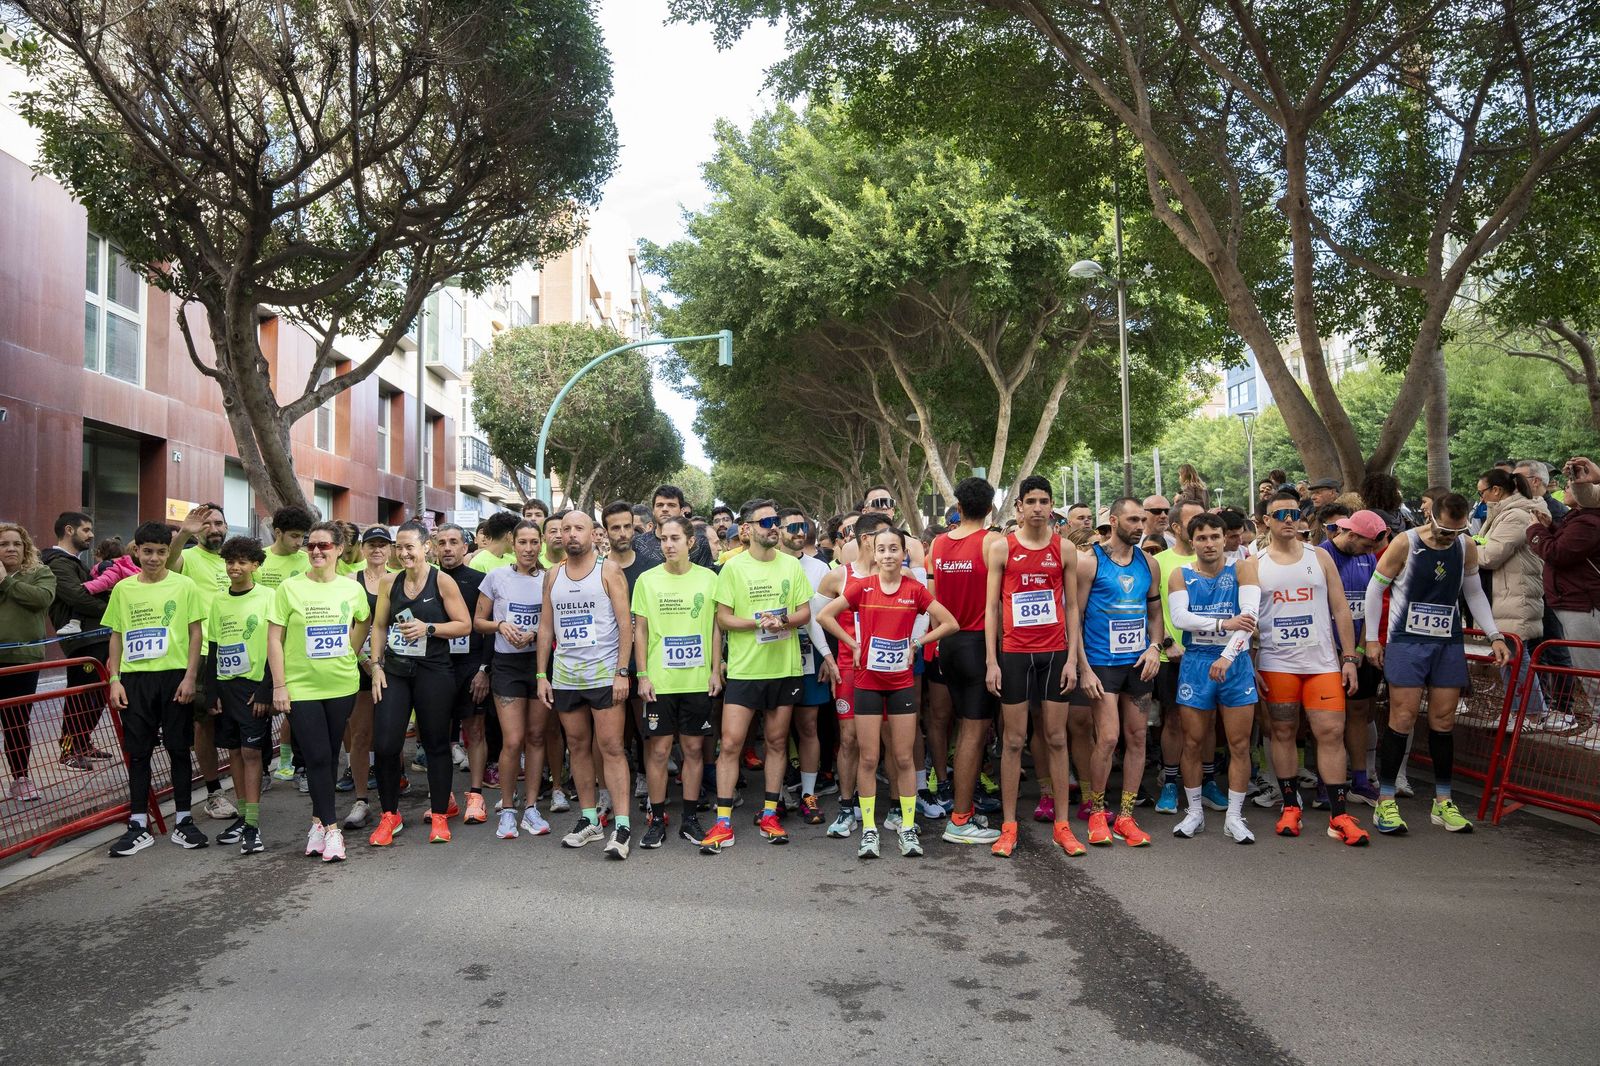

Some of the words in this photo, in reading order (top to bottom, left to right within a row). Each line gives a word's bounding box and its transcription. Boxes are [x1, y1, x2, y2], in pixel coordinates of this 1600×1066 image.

[1273, 588, 1313, 604] ALSI
[556, 602, 595, 610] CUELLAR
[1021, 603, 1050, 617] 884
[514, 615, 538, 625] 380
[1412, 614, 1449, 628] 1136
[564, 627, 588, 639] 445
[1119, 631, 1140, 644] 621
[1280, 627, 1309, 639] 349
[128, 639, 163, 653] 1011
[314, 636, 343, 649] 294
[667, 647, 701, 659] 1032
[876, 651, 904, 663] 232
